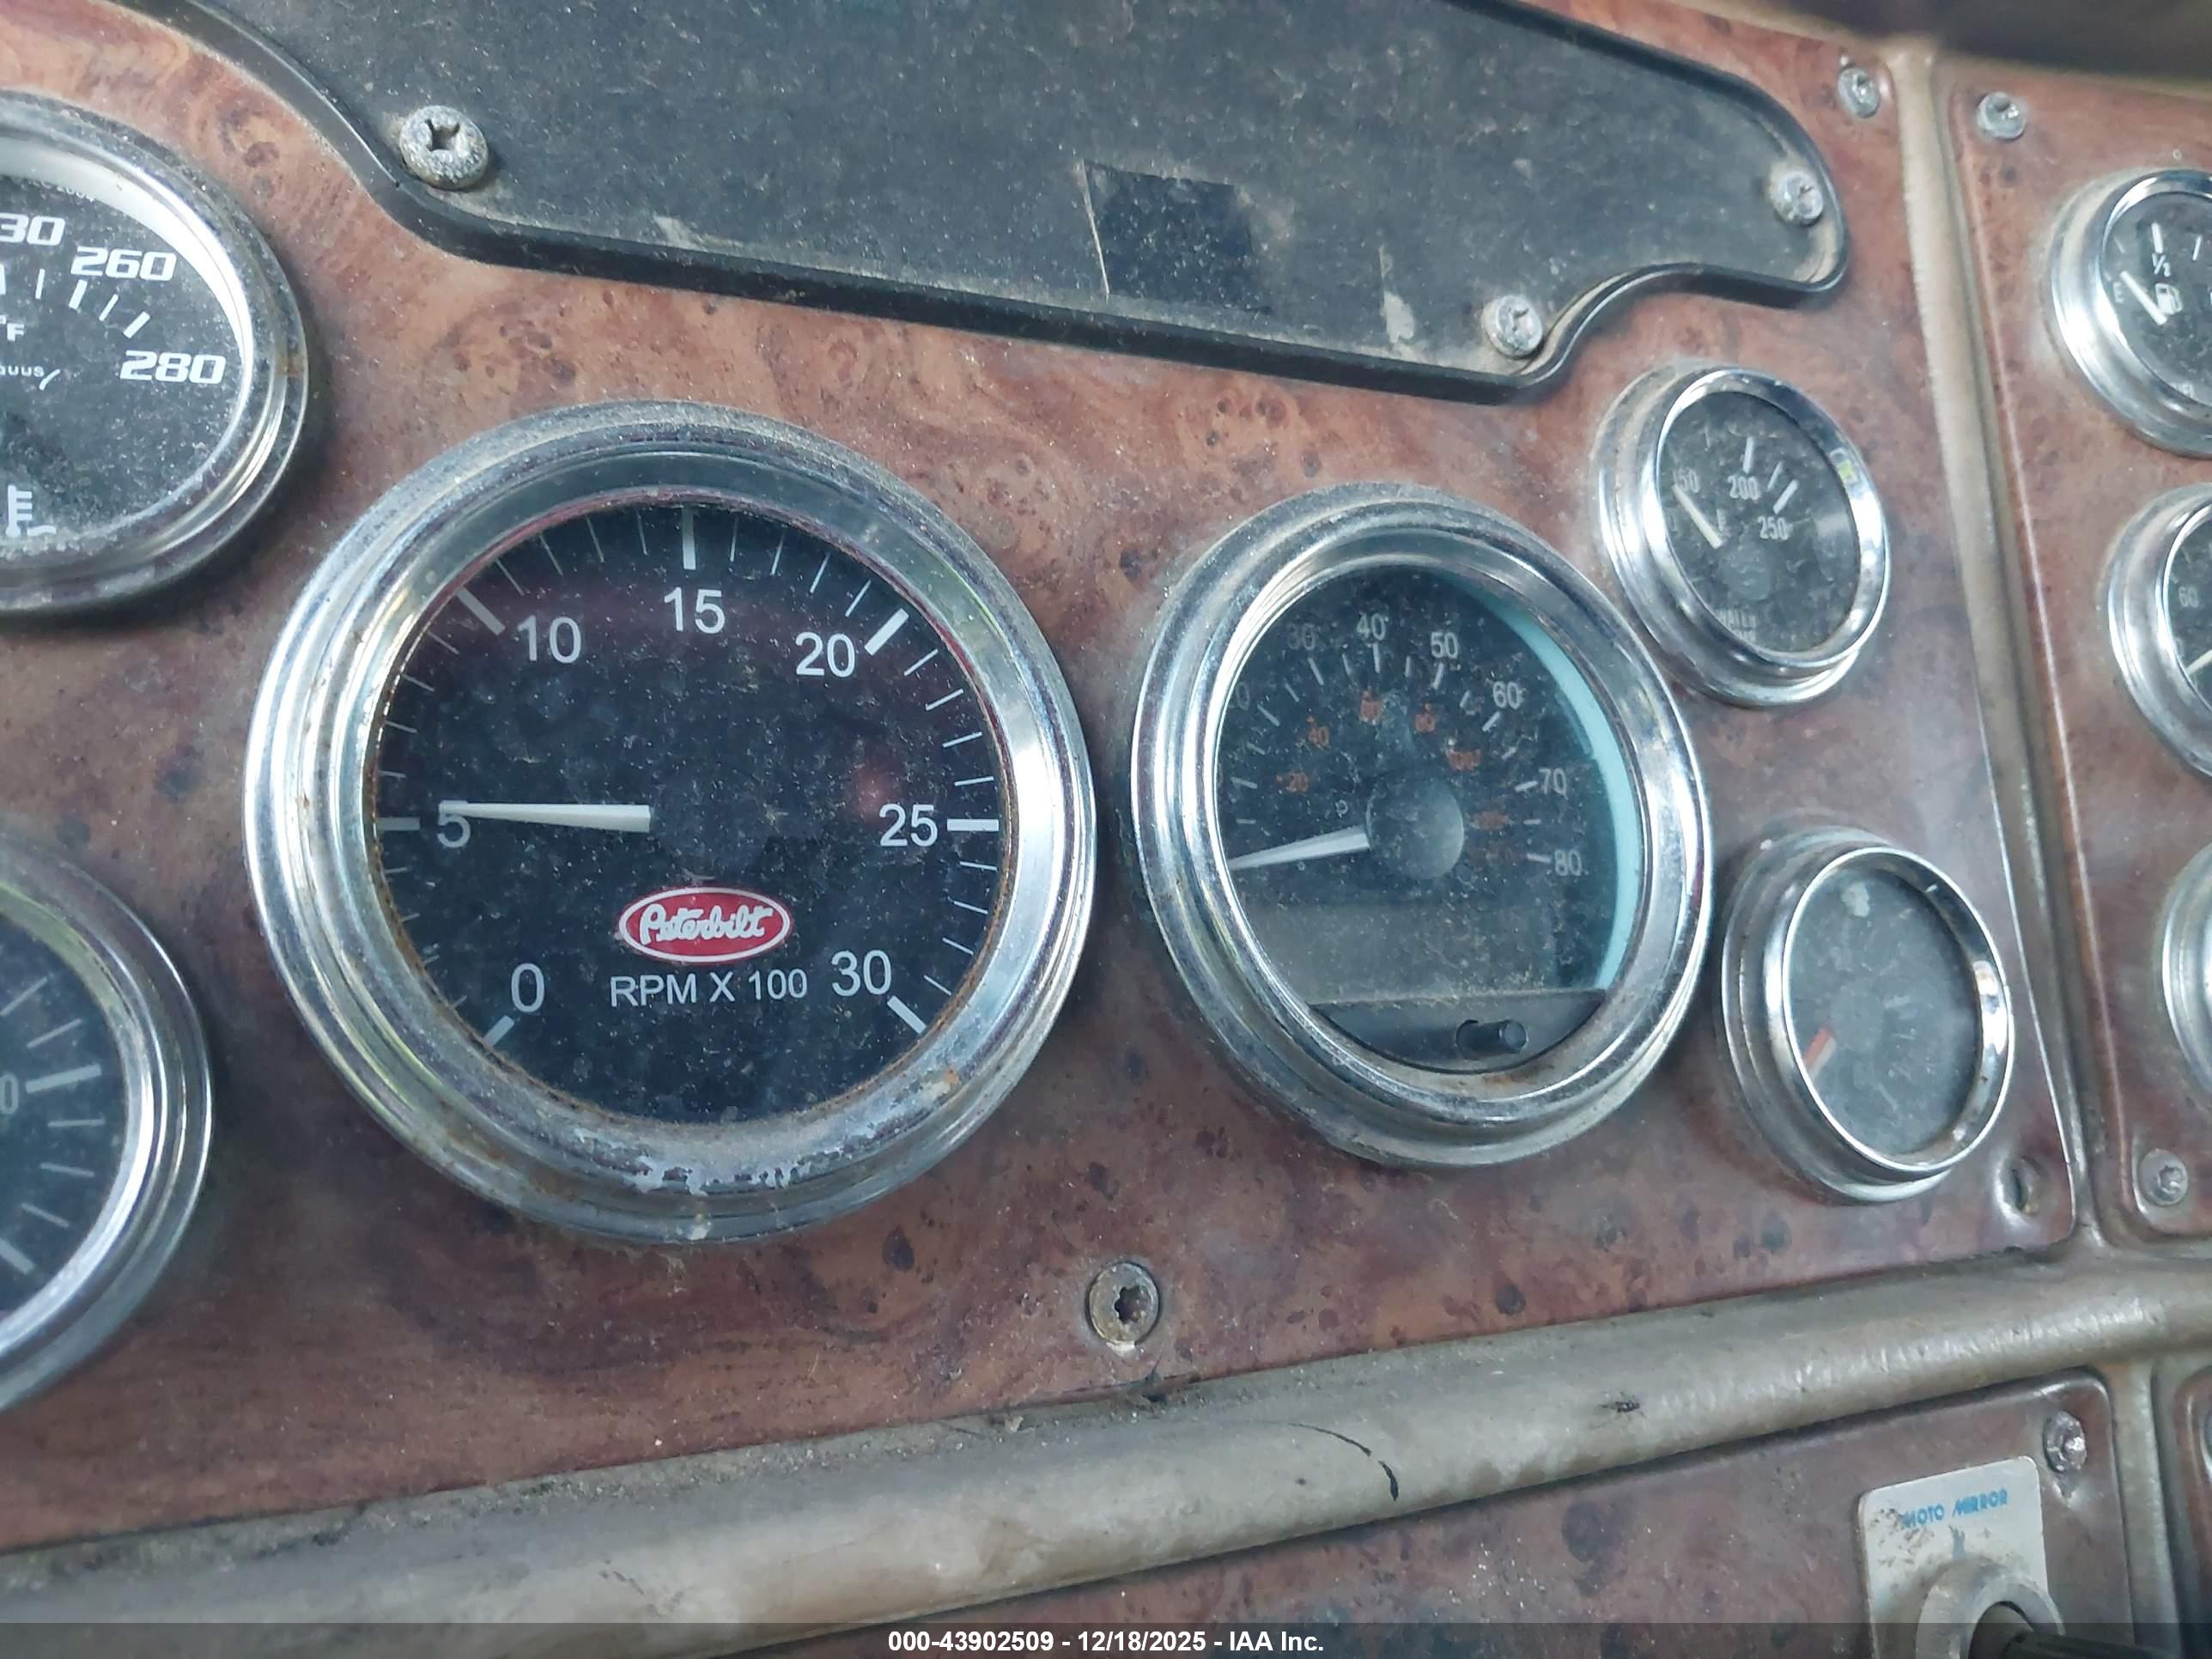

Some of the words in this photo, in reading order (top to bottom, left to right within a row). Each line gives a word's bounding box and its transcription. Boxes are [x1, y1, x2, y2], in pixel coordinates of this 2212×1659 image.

[70, 246, 178, 281] 260
[120, 349, 227, 384] 280
[1728, 476, 1760, 500] 200
[1759, 515, 1790, 540] 250
[664, 586, 726, 634] 15
[1357, 612, 1388, 641] 40
[517, 615, 582, 664] 10
[795, 631, 856, 678] 20
[1430, 631, 1459, 659] 50
[1492, 682, 1522, 710] 60
[1538, 769, 1566, 795] 70
[437, 799, 471, 848] 5
[878, 803, 939, 848] 25
[1554, 850, 1582, 876] 80
[639, 902, 775, 946] Peterbilt
[510, 963, 544, 1013] 0
[611, 975, 697, 1007] RPM
[709, 971, 736, 1003] X
[747, 969, 807, 1000] 100
[830, 950, 892, 996] 30
